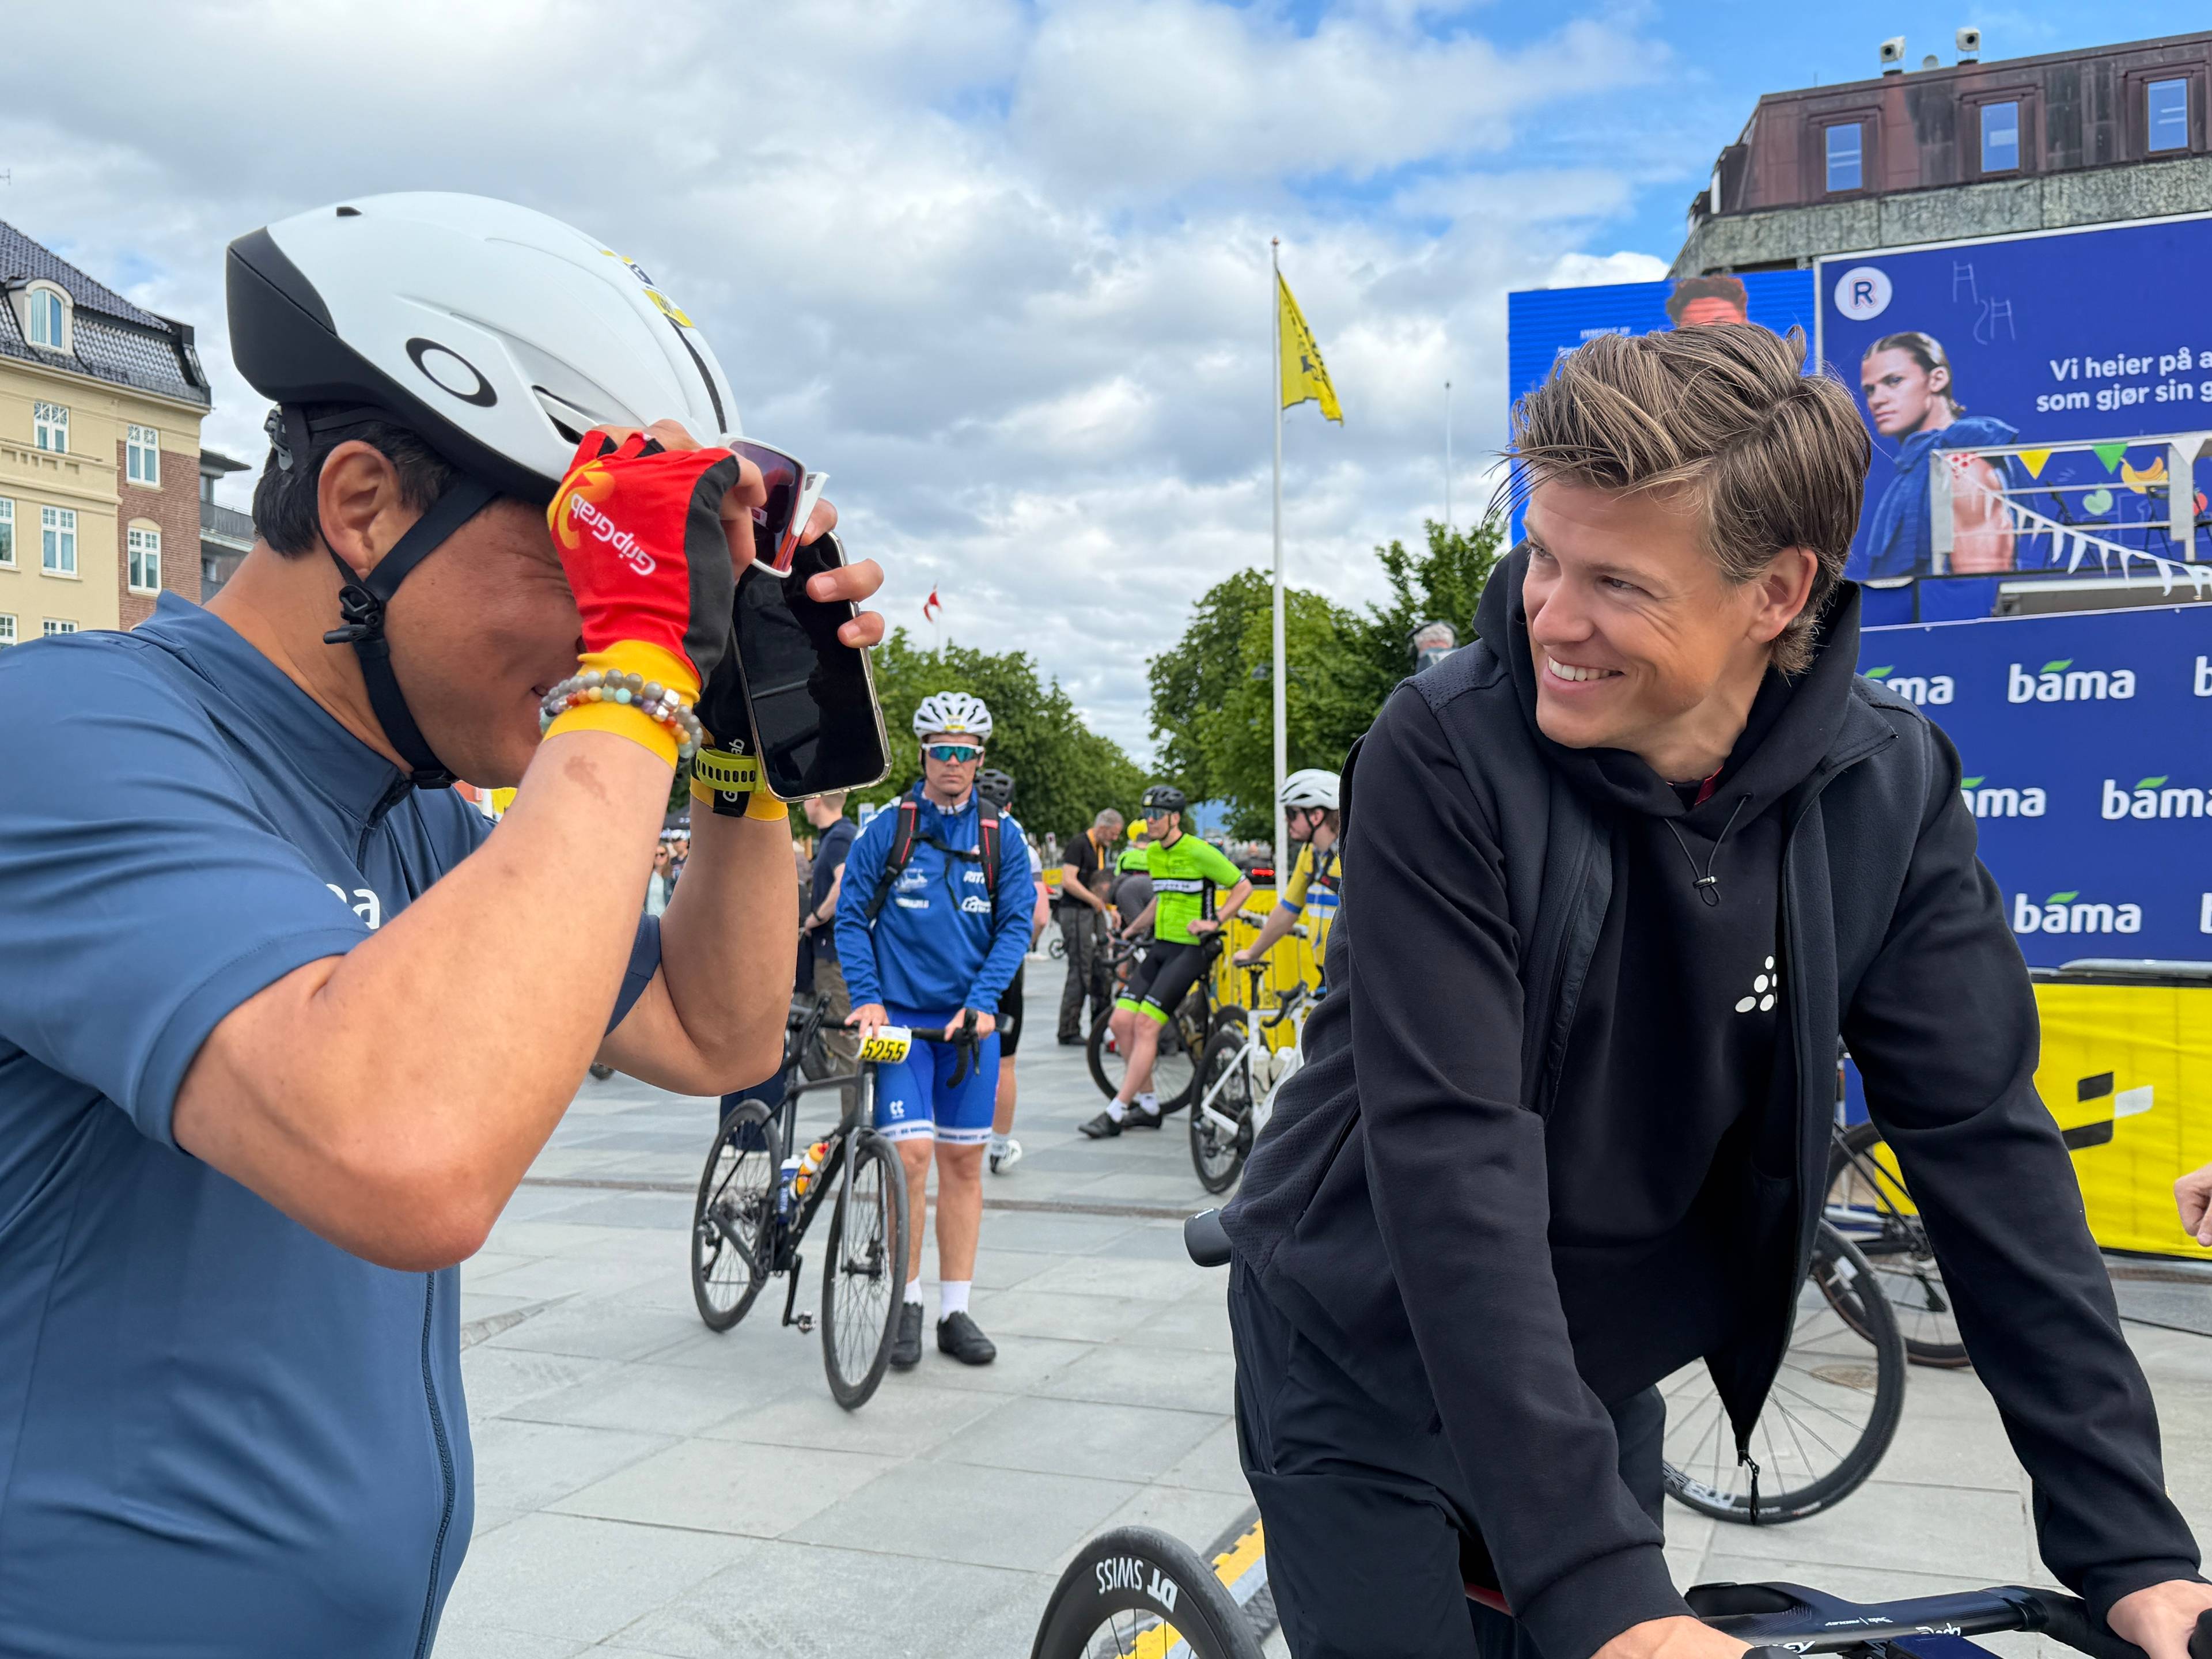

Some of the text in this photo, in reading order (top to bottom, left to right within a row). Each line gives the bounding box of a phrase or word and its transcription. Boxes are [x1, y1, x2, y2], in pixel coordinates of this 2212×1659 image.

[1850, 278, 1876, 308] R
[2050, 358, 2078, 381] Vi
[2085, 353, 2154, 378] heier
[2159, 346, 2192, 377] på
[2036, 391, 2090, 412] som
[2096, 383, 2150, 411] gjør
[2155, 378, 2194, 402] sin
[571, 493, 656, 576] GripGrab
[1871, 676, 1954, 705] ma
[861, 1037, 906, 1062] 5255
[1096, 1557, 1179, 1613] DT SWISS
